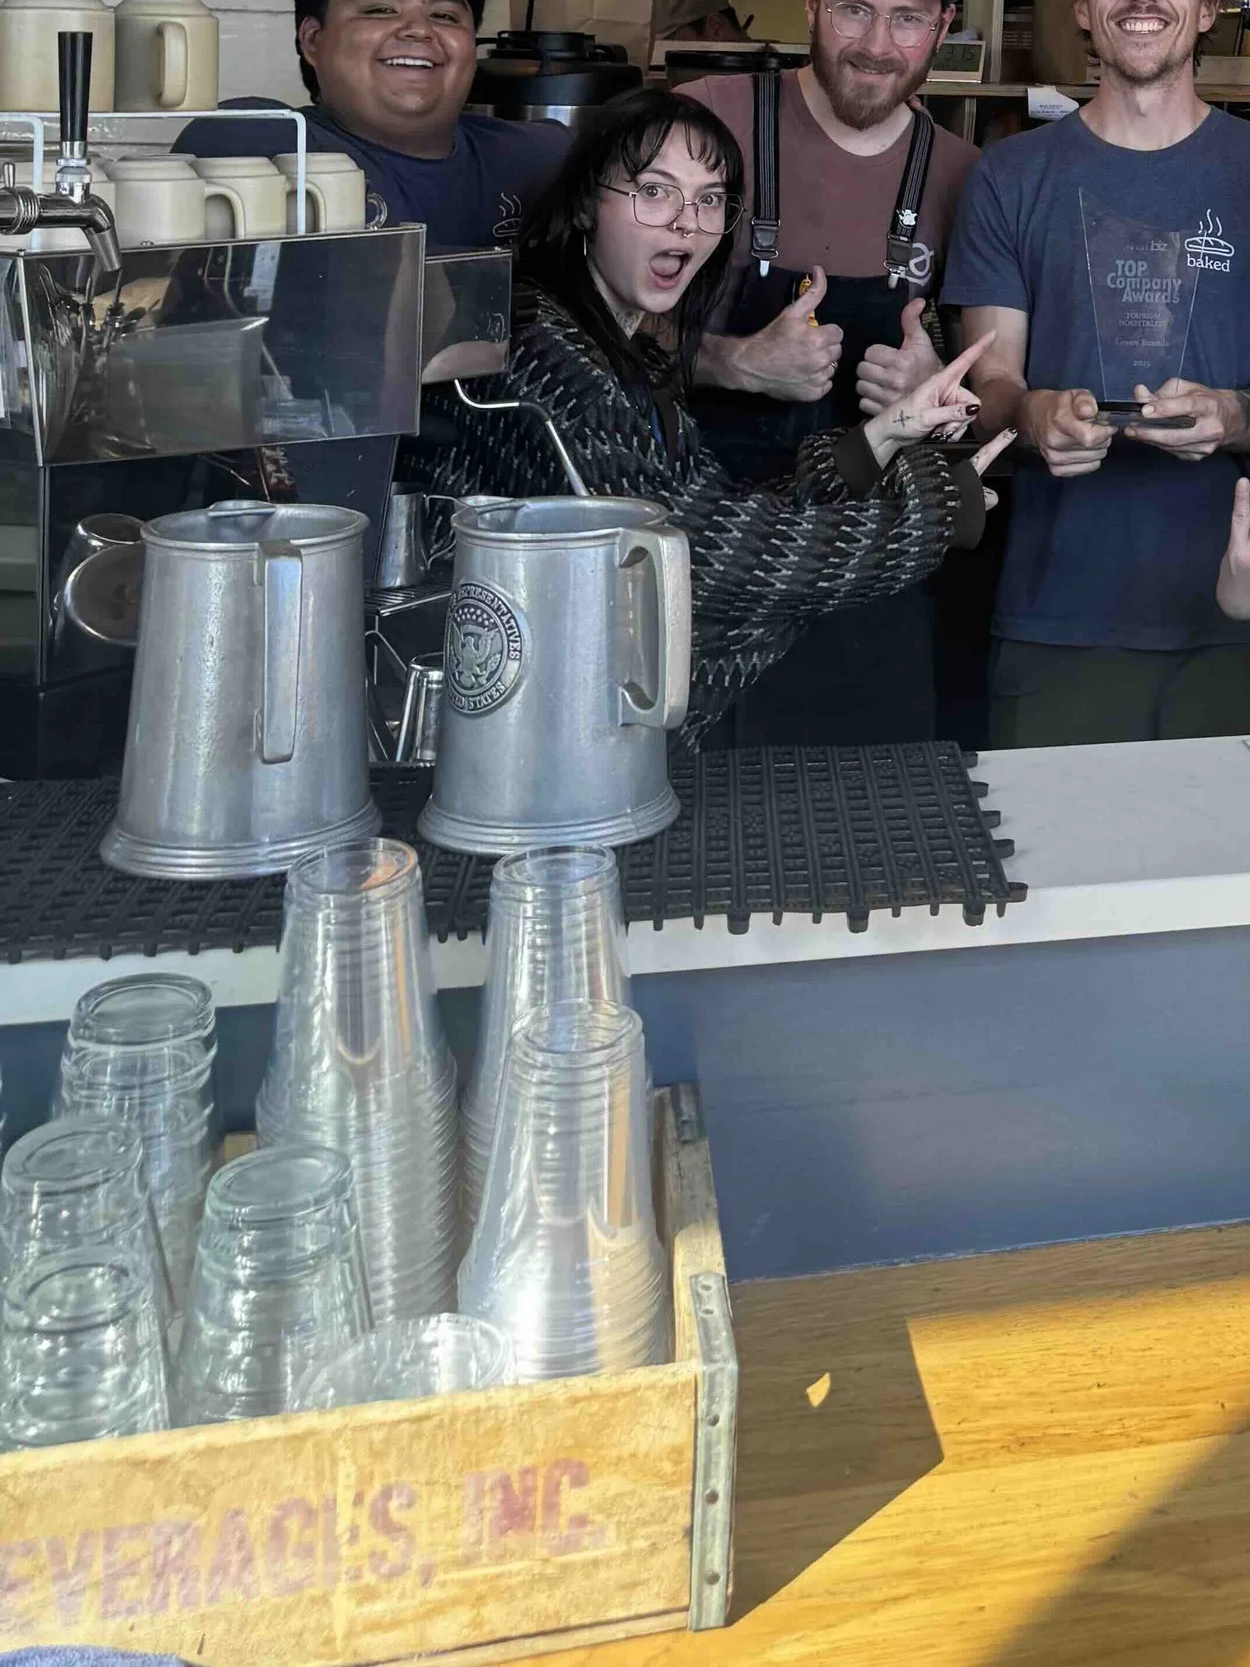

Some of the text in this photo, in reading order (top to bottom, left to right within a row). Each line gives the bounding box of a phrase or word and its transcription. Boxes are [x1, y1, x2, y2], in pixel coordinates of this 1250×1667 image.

[1116, 260, 1148, 277] TOP
[1187, 254, 1230, 272] baked
[1107, 273, 1182, 291] Company
[1121, 285, 1180, 304] Awards
[468, 681, 506, 710] STATES
